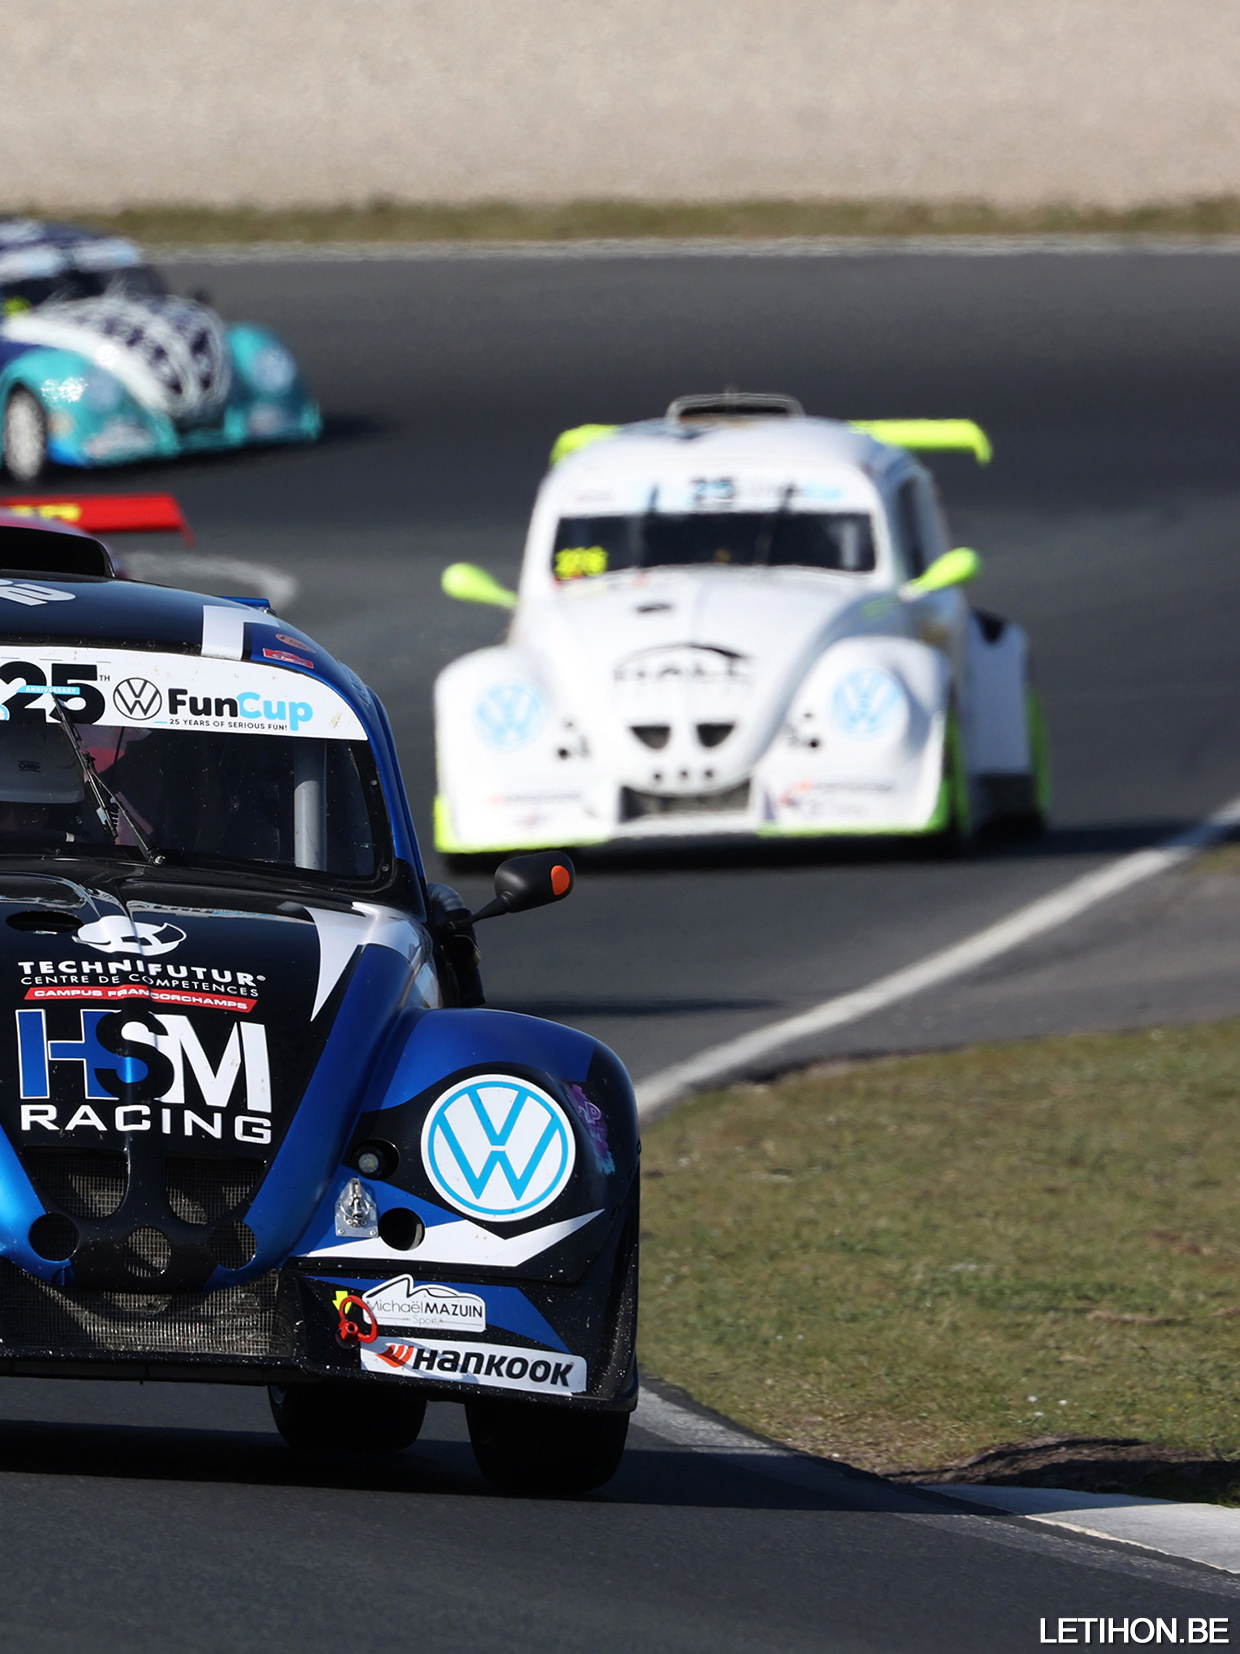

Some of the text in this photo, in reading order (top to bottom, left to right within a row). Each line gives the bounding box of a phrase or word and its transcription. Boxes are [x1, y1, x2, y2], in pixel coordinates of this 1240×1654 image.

[25, 686, 77, 695] ANNIVERSARY
[99, 674, 110, 682] TH
[168, 688, 313, 731] FunCup
[183, 719, 210, 727] YEARS
[213, 720, 225, 728] OF
[228, 721, 265, 730] SERIOUS
[268, 723, 288, 731] FUN!
[17, 960, 258, 987] TECHNIFUTUR
[21, 973, 259, 997] CENTRE DE COMPETENCES
[34, 987, 248, 1010] CAMPUS FRANCORCHAMPS
[15, 1008, 272, 1113] HSM
[20, 1104, 272, 1144] RACING
